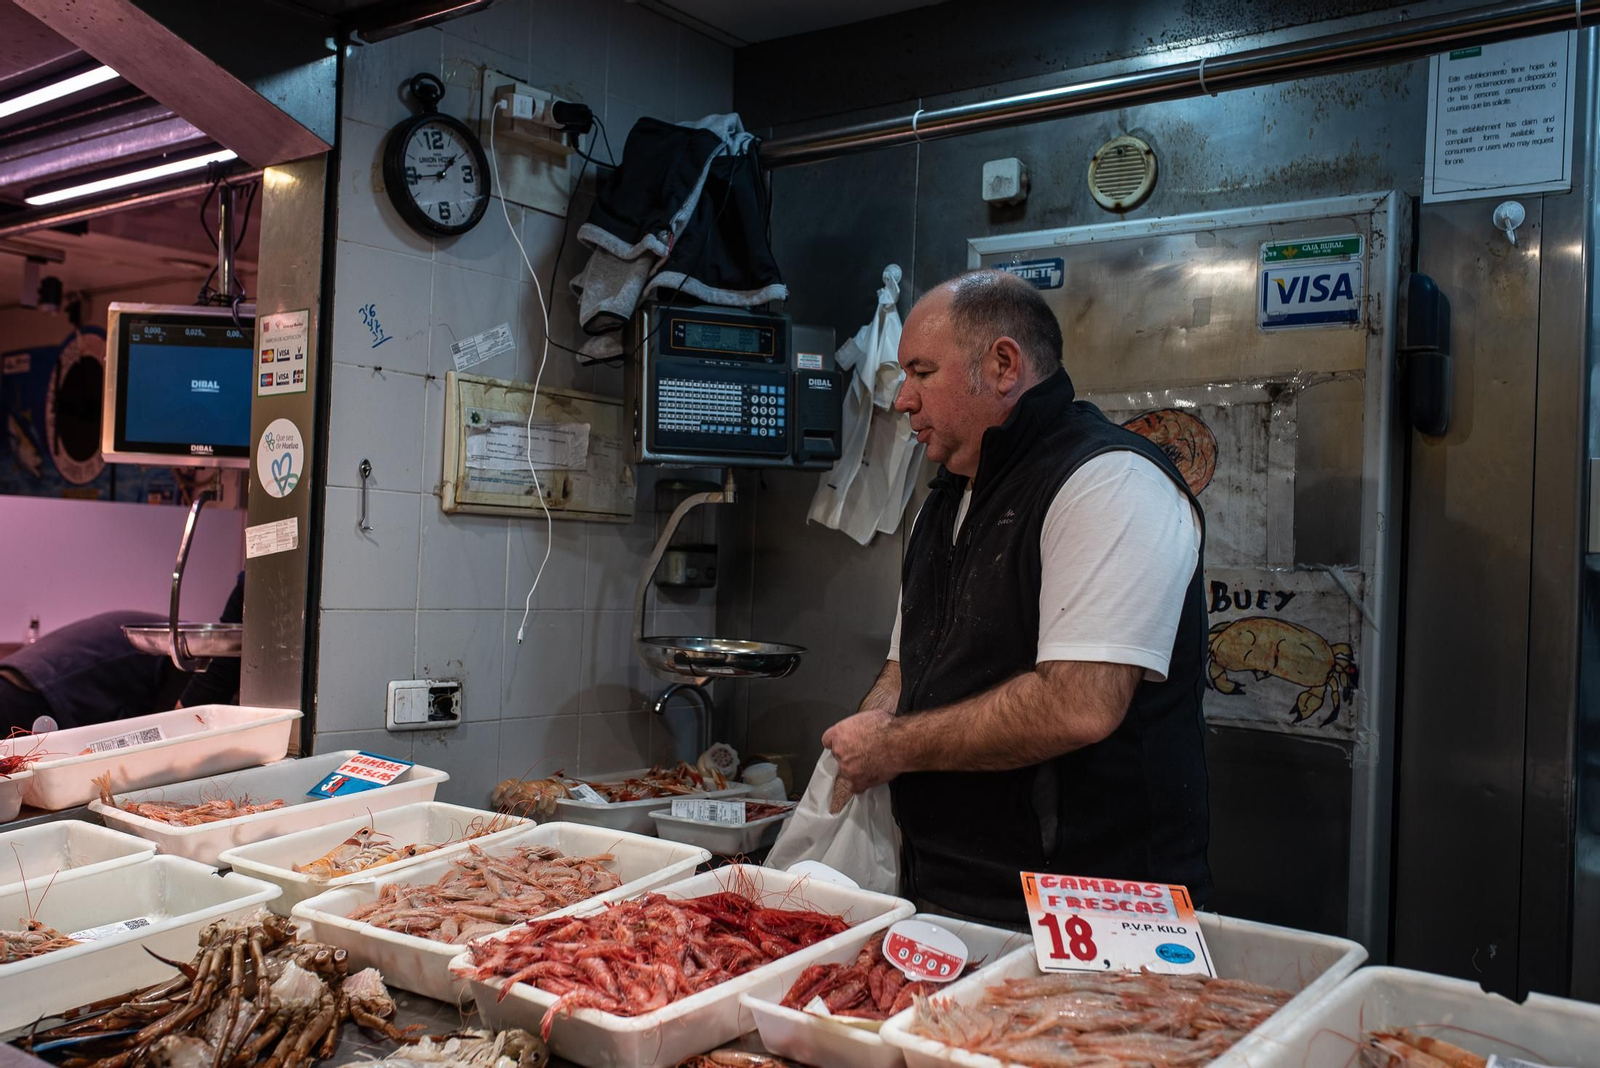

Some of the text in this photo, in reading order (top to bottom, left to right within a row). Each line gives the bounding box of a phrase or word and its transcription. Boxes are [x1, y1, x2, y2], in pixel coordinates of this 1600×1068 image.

[1464, 68, 1507, 80] establecimiento
[1529, 62, 1545, 72] hojas
[1448, 84, 1466, 93] quejas
[1475, 78, 1515, 89] reclamaciones
[1525, 71, 1557, 82] disposición
[1474, 90, 1500, 100] personas
[1505, 83, 1546, 94] consumidoras
[1447, 103, 1470, 113] usuarias
[1471, 102, 1482, 110] que
[1462, 124, 1501, 134] establishment
[423, 131, 444, 150] 12
[1445, 136, 1472, 147] complaint
[1445, 146, 1476, 156] consumers
[1516, 140, 1530, 149] may
[1531, 137, 1554, 146] request
[462, 165, 474, 183] 3
[438, 202, 451, 220] 6
[1271, 273, 1354, 304] VISA
[191, 380, 219, 389] DIBAL
[809, 378, 832, 387] DIBAL
[1208, 580, 1296, 614] BUEY
[340, 764, 396, 781] FRESCAS
[350, 756, 403, 772] GAMBAS
[321, 775, 349, 794] 35
[1040, 876, 1163, 898] GAMBAS
[1048, 895, 1168, 914] FRESCAS
[1122, 922, 1187, 934] P.V.P. KILO
